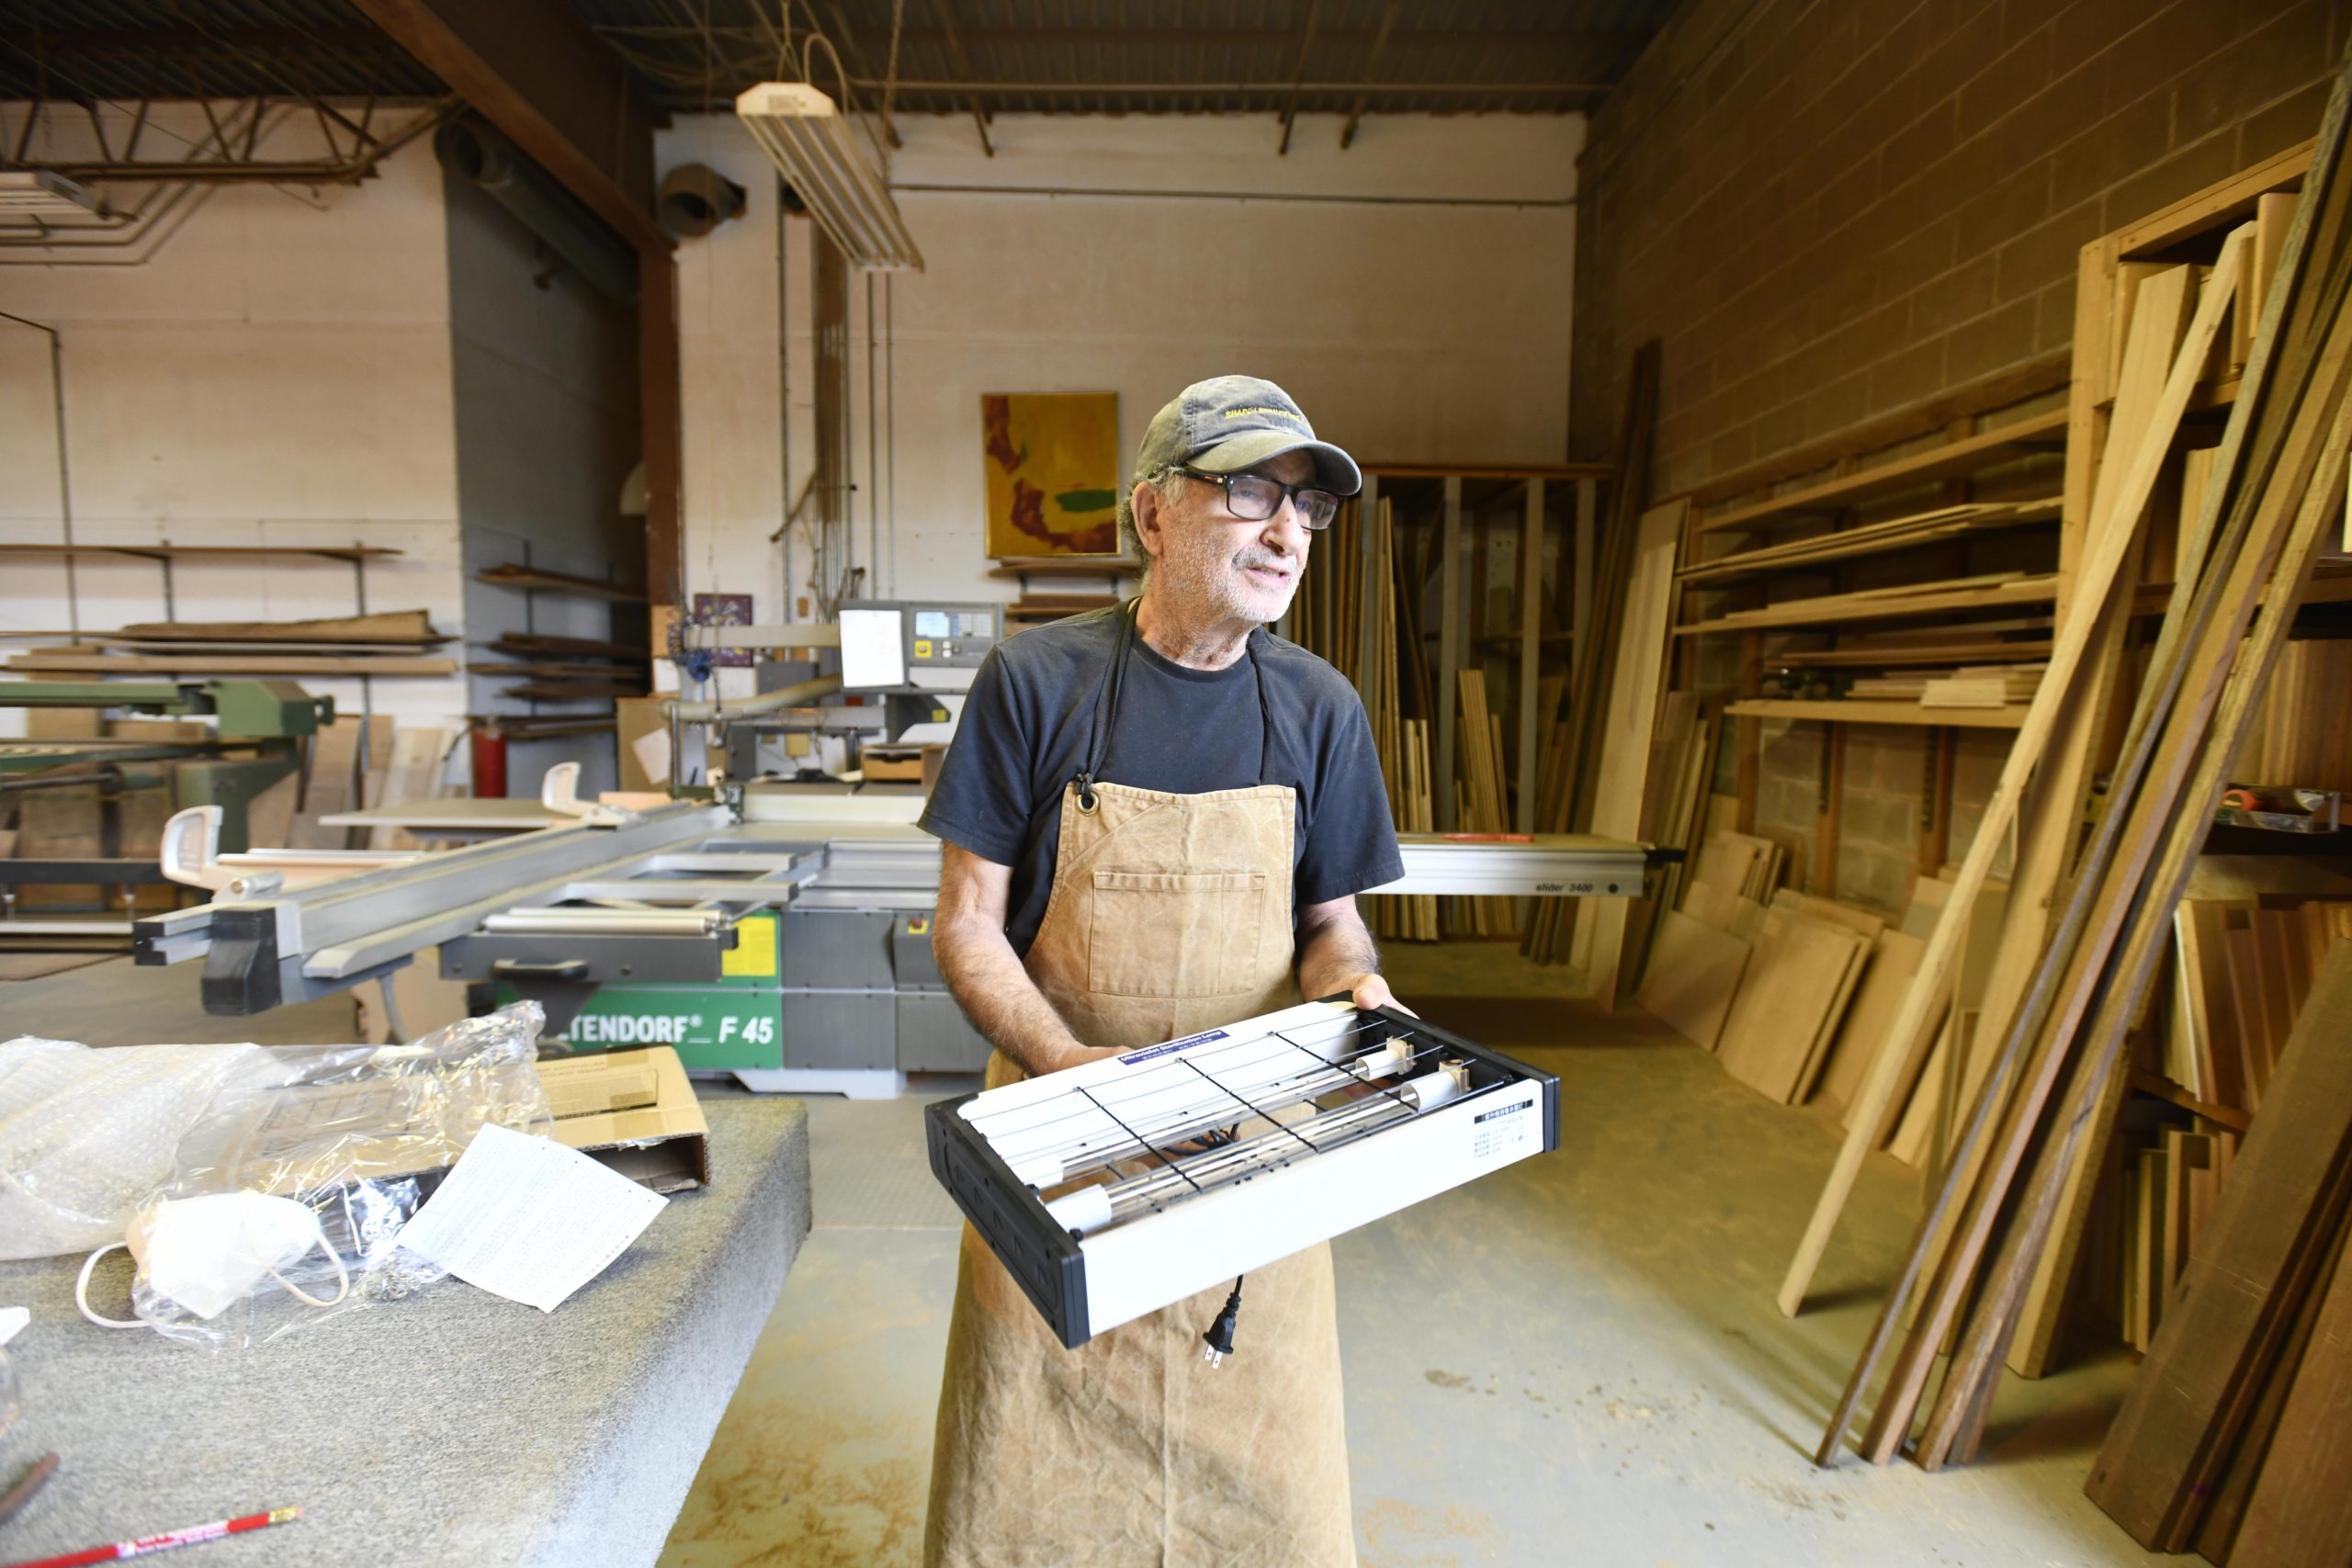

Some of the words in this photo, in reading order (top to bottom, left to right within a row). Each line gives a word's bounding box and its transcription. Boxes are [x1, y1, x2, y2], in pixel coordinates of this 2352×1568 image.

[1569, 883, 1594, 893] 3400
[718, 1016, 739, 1044] F
[741, 1016, 775, 1044] 45
[1120, 1047, 1159, 1061] Ultraviolet
[1202, 1031, 1222, 1039] Lamp
